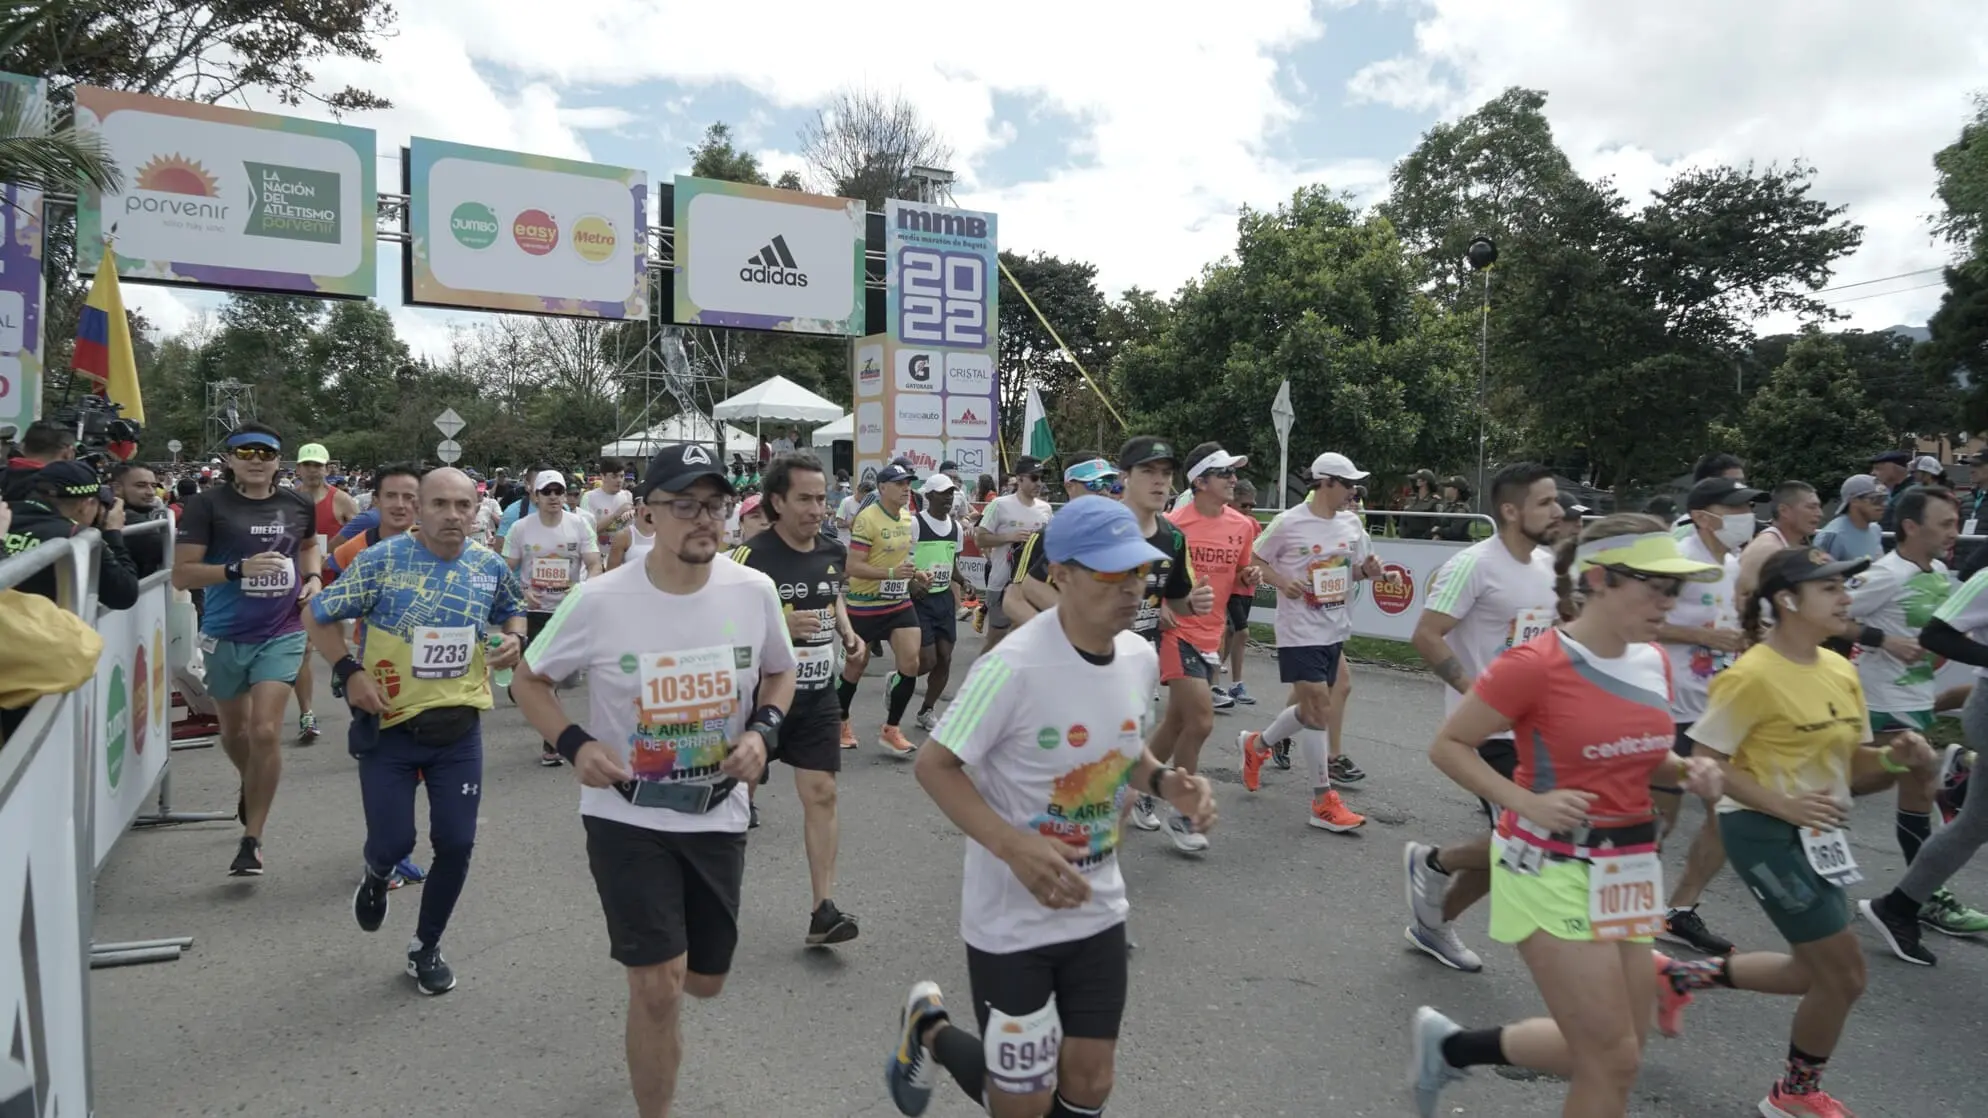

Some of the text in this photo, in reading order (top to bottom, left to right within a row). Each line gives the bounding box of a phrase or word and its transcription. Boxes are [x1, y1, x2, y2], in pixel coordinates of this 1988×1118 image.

[263, 169, 280, 181] LA
[263, 181, 315, 197] NACIÓN
[263, 192, 289, 204] DEL
[125, 196, 229, 219] porvenir
[263, 204, 336, 221] ATLETISMO
[262, 216, 334, 234] porvenir
[452, 218, 498, 233] JUMBO
[515, 223, 557, 242] easy
[574, 230, 615, 246] Metro
[740, 265, 808, 287] adidas
[950, 367, 989, 379] CRISTAL
[250, 525, 284, 535] DIEGO
[1374, 582, 1412, 600] easy
[423, 644, 469, 664] 7233
[648, 670, 732, 705] 10355
[658, 721, 699, 737] ARTE
[1047, 800, 1111, 820] EL ARTE
[1597, 880, 1654, 915] 10779
